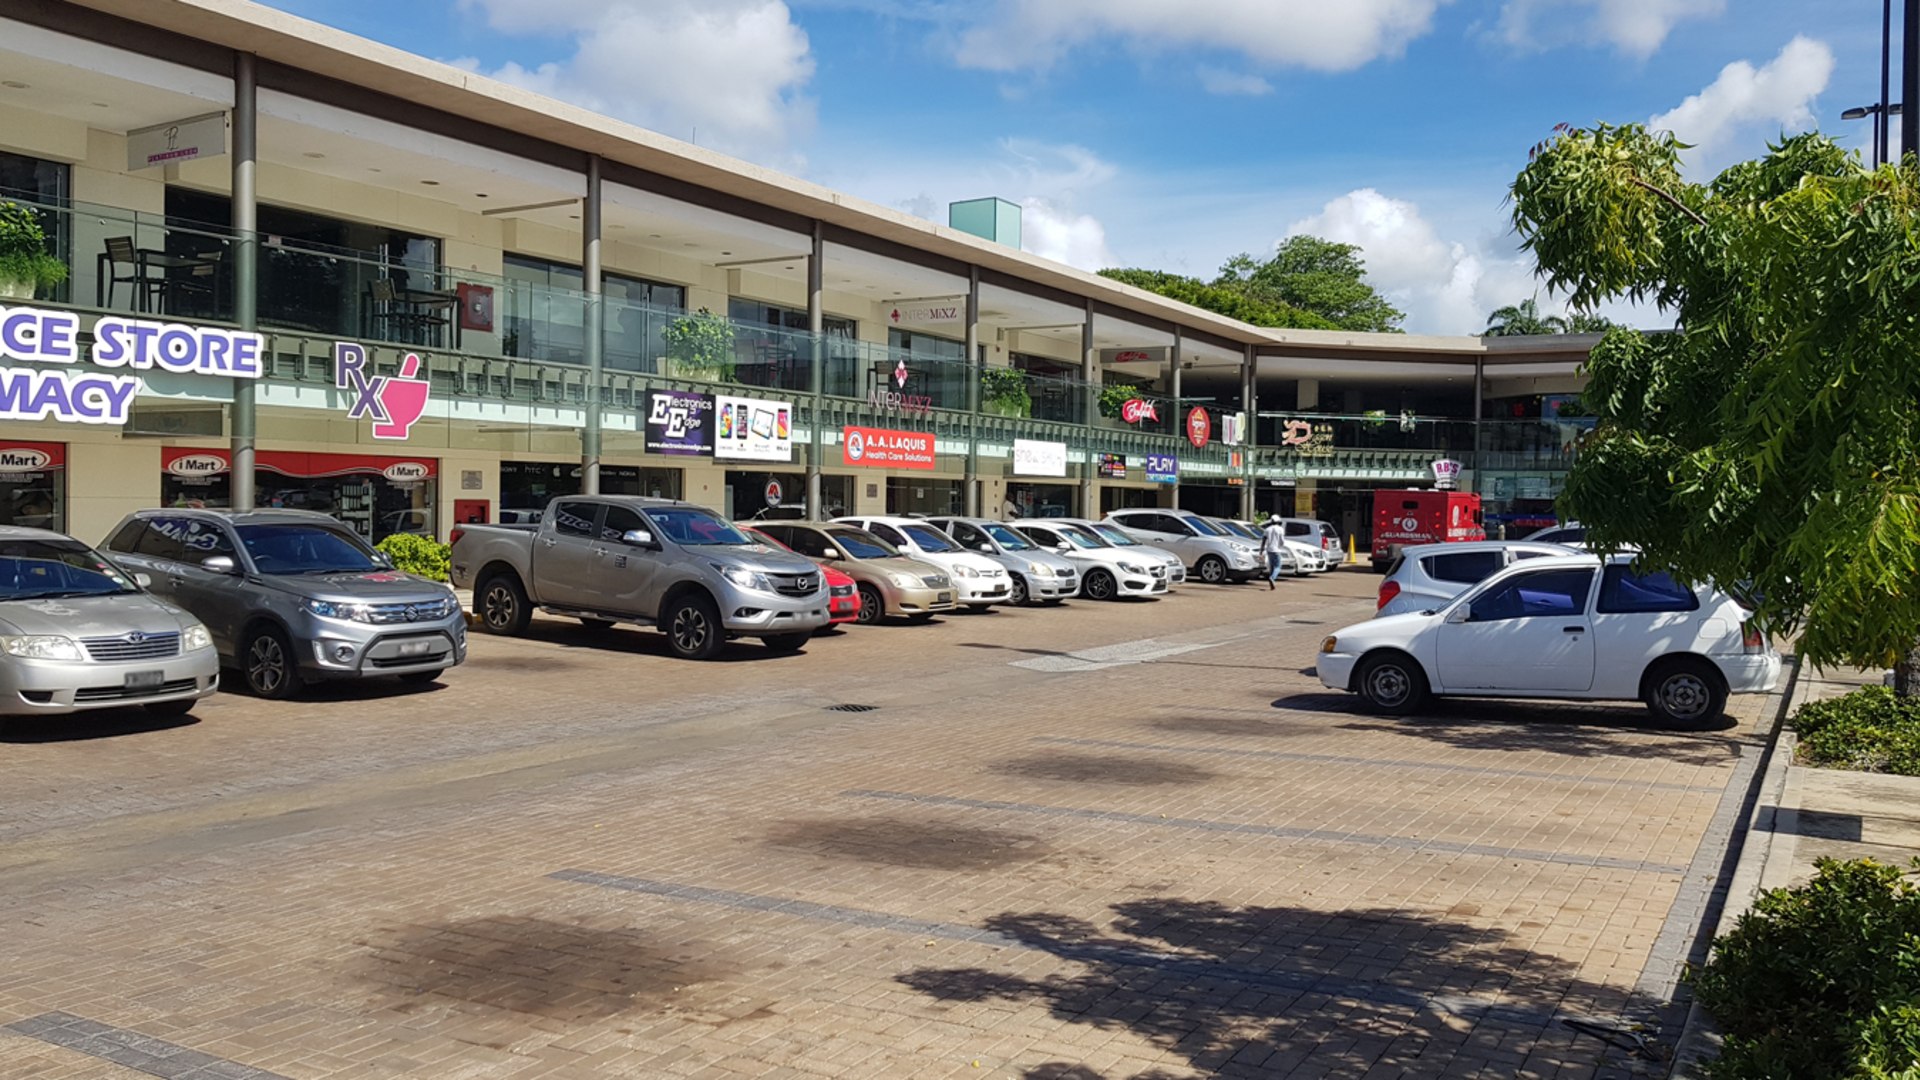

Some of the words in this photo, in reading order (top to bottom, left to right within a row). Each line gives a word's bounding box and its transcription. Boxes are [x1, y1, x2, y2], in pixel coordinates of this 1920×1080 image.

[97, 321, 260, 374] STORE
[0, 372, 136, 419] MACY
[1, 453, 37, 466] Mart
[865, 450, 887, 460] Health
[887, 451, 903, 461] Care
[904, 452, 932, 463] Solutions
[185, 459, 216, 470] Mart
[396, 466, 420, 476] Mart
[1148, 456, 1175, 473] PLAY
